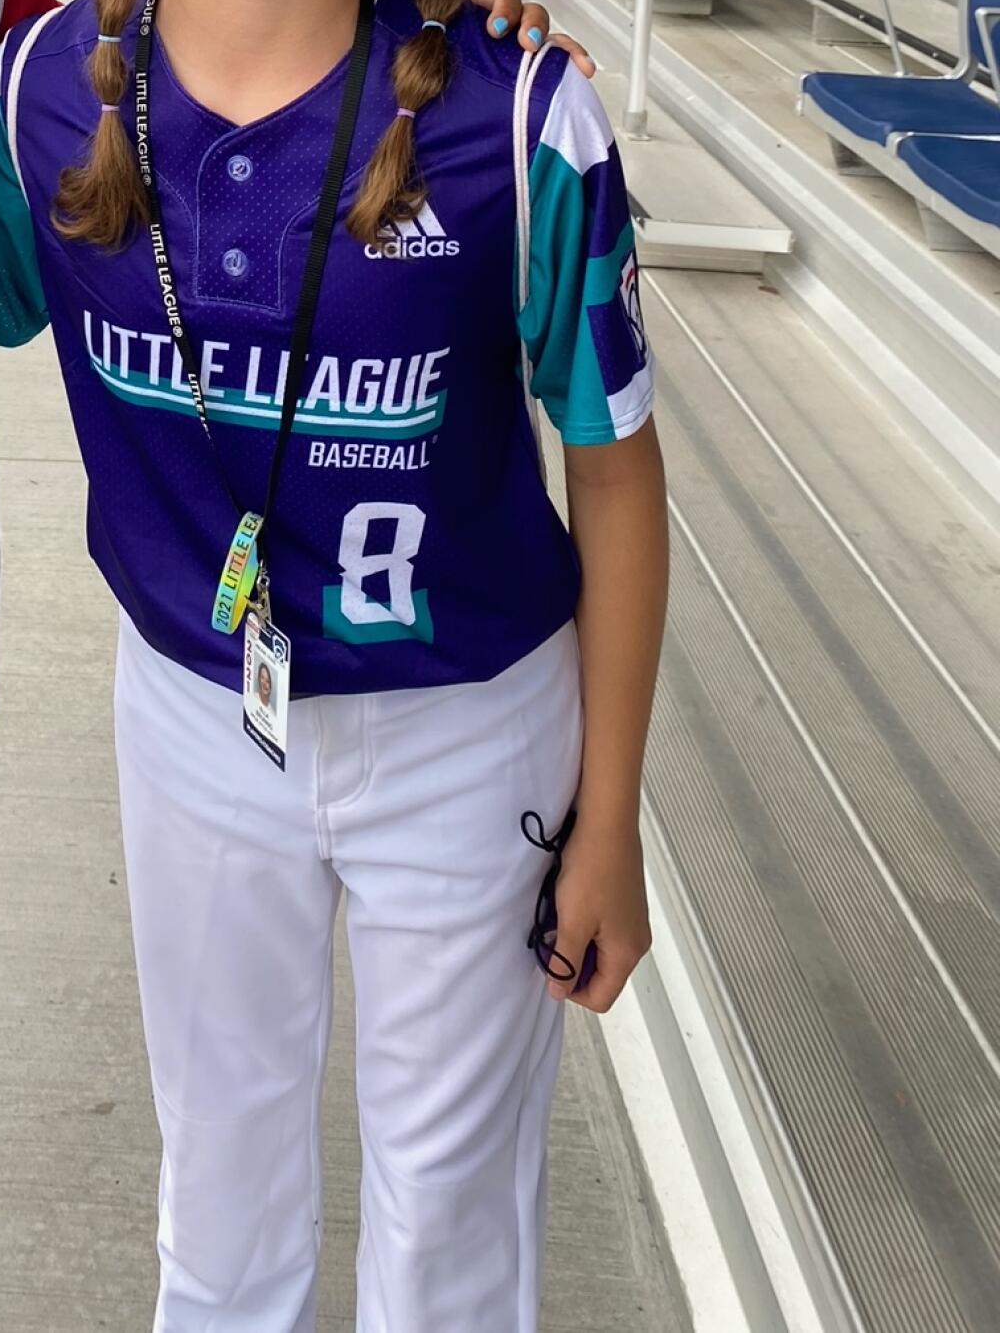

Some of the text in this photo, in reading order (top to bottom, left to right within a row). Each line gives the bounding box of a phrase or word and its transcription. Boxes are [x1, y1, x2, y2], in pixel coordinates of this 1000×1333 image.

[135, 72, 148, 113] LITTLE
[150, 224, 167, 264] LITTLE
[364, 236, 460, 260] adidas
[84, 310, 230, 398] LITTLE
[224, 539, 249, 590] LITTLE
[338, 502, 426, 626] 8
[216, 590, 233, 627] 2021
